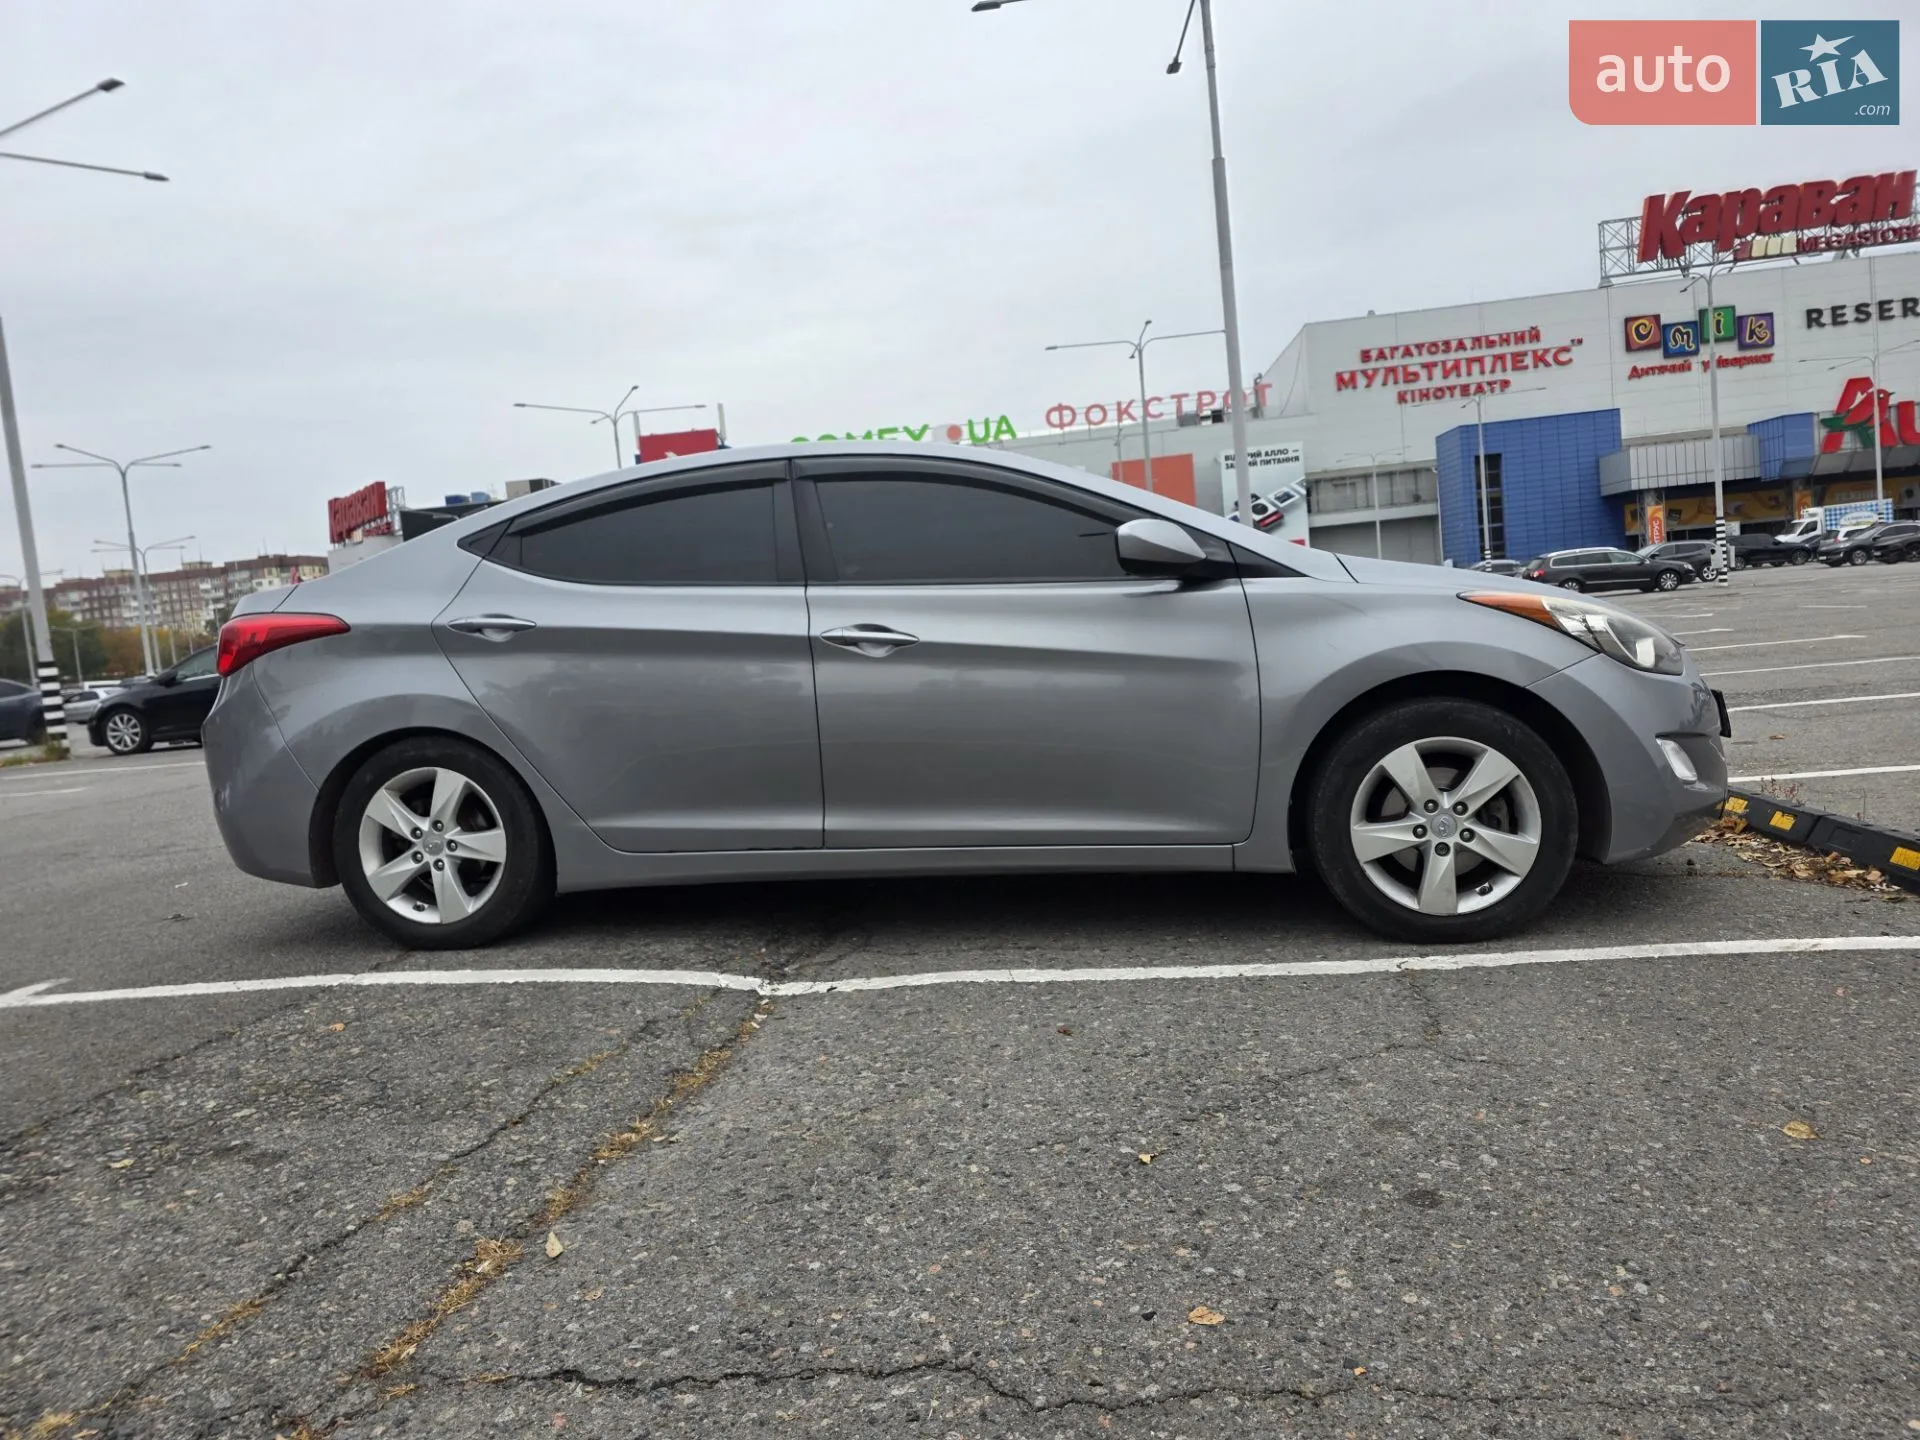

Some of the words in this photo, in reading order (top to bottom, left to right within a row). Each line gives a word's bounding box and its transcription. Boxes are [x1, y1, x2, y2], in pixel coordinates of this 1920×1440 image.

[1637, 169, 1917, 263] Караван
[1806, 297, 1920, 329] RESER
[1360, 326, 1541, 363] БАГАТОЗАЛЬНИЙ
[1335, 345, 1574, 391] МУЛЬТИПЛЕКС
[1701, 353, 1775, 373] уівермаг
[1396, 379, 1512, 405] КІНОТЕАТР
[1260, 455, 1300, 466] ПИТАННЯ
